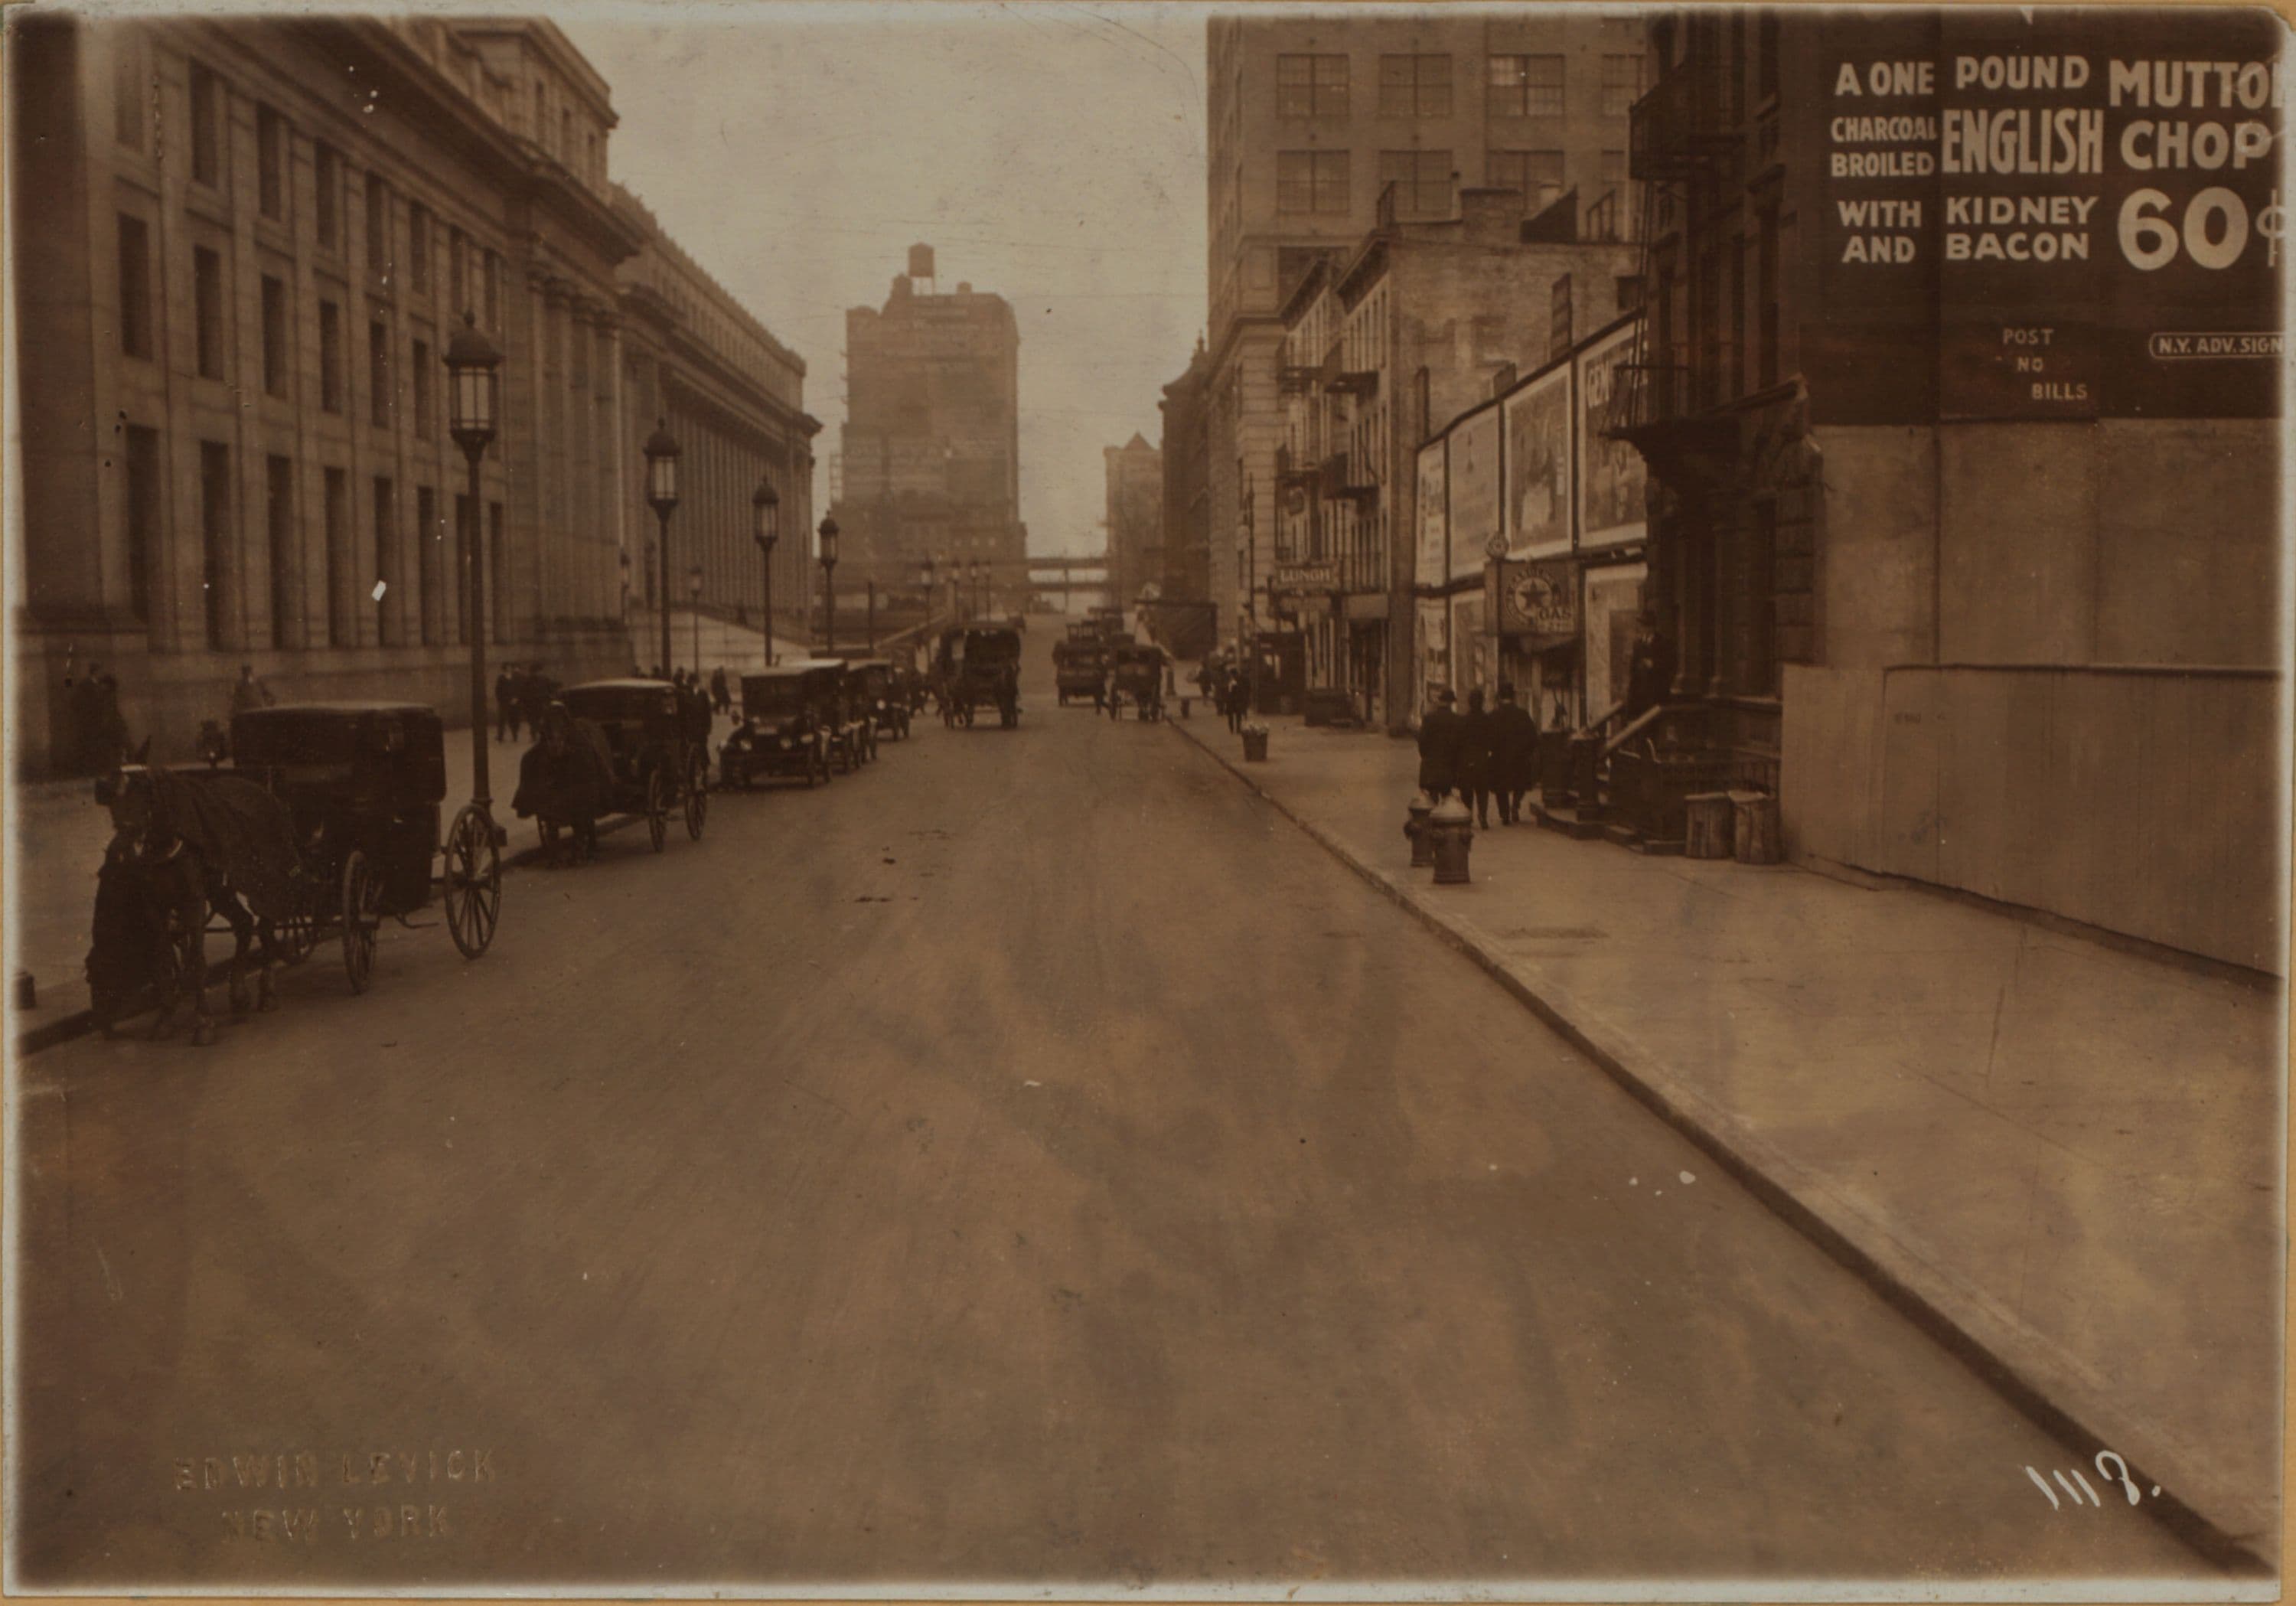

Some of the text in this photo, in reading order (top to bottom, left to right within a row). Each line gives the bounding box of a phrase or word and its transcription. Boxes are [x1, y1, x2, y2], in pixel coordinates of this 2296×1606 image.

[1835, 64, 1862, 95] A
[1870, 61, 1935, 95] ONE
[1956, 56, 2089, 90] POUND
[1830, 116, 1937, 142] CHARCOAL
[1942, 109, 2272, 174] ENGLISH CHOP
[1831, 152, 1935, 177] BROILED
[1838, 196, 2099, 227] WITH KIDNEY
[1841, 232, 2089, 263] AND BACON
[2003, 328, 2053, 345] POST
[2017, 357, 2043, 373] NO
[2031, 384, 2087, 400] BILLS
